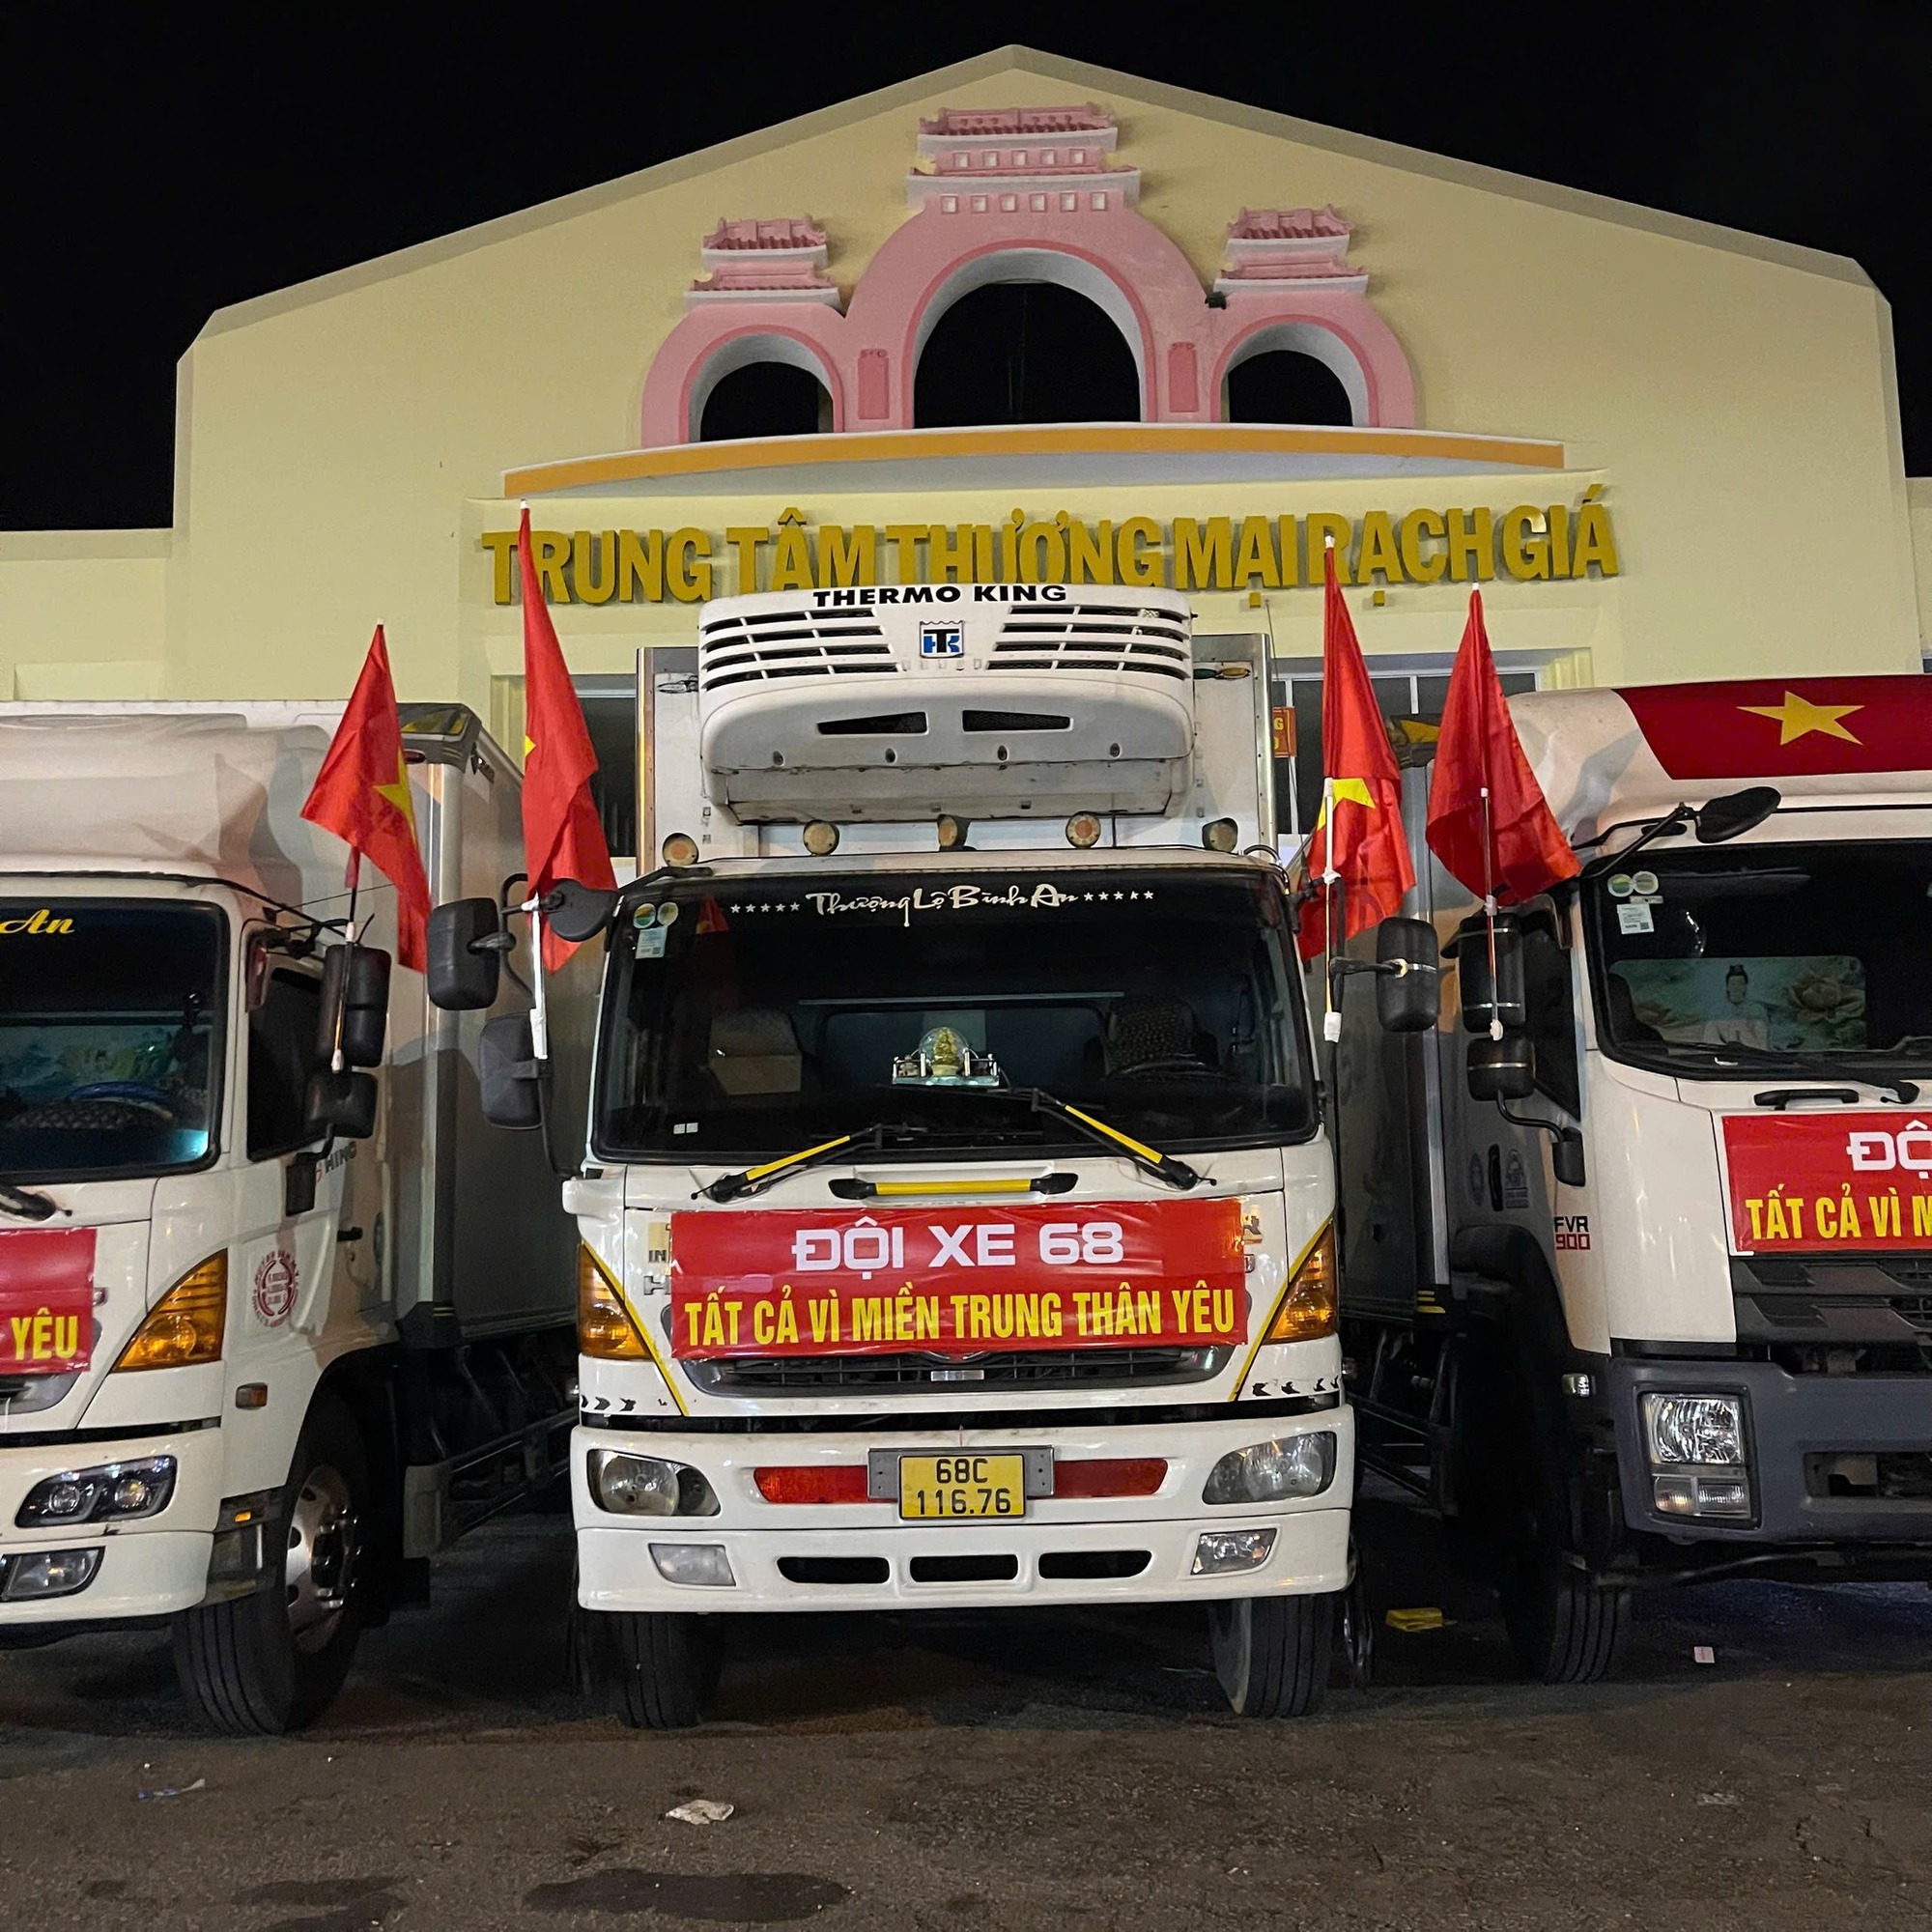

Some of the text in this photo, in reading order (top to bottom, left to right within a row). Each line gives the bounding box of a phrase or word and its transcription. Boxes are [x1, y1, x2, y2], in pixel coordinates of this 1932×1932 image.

[482, 483, 1619, 608] TRUNG TÂM THƯƠNG MẠI RẠCH GIÁ
[813, 584, 1066, 608] THERMO KING
[1031, 883, 1079, 908] An
[1846, 1120, 1932, 1179] ĐỘ
[1554, 1216, 1588, 1233] FVR
[1746, 1183, 1804, 1239] TẤT
[1815, 1182, 1861, 1238] CẢ
[1868, 1186, 1902, 1237] VÌ
[791, 1215, 1124, 1280] ĐỘI XE 68
[1555, 1234, 1591, 1250] 900
[685, 1279, 1235, 1347] TẤT CẢ VÌ MIỀN TRUNG THÂN YÊU
[11, 1307, 78, 1361] YÊU
[936, 1459, 988, 1483] 68C
[917, 1489, 1010, 1515] 116.76
